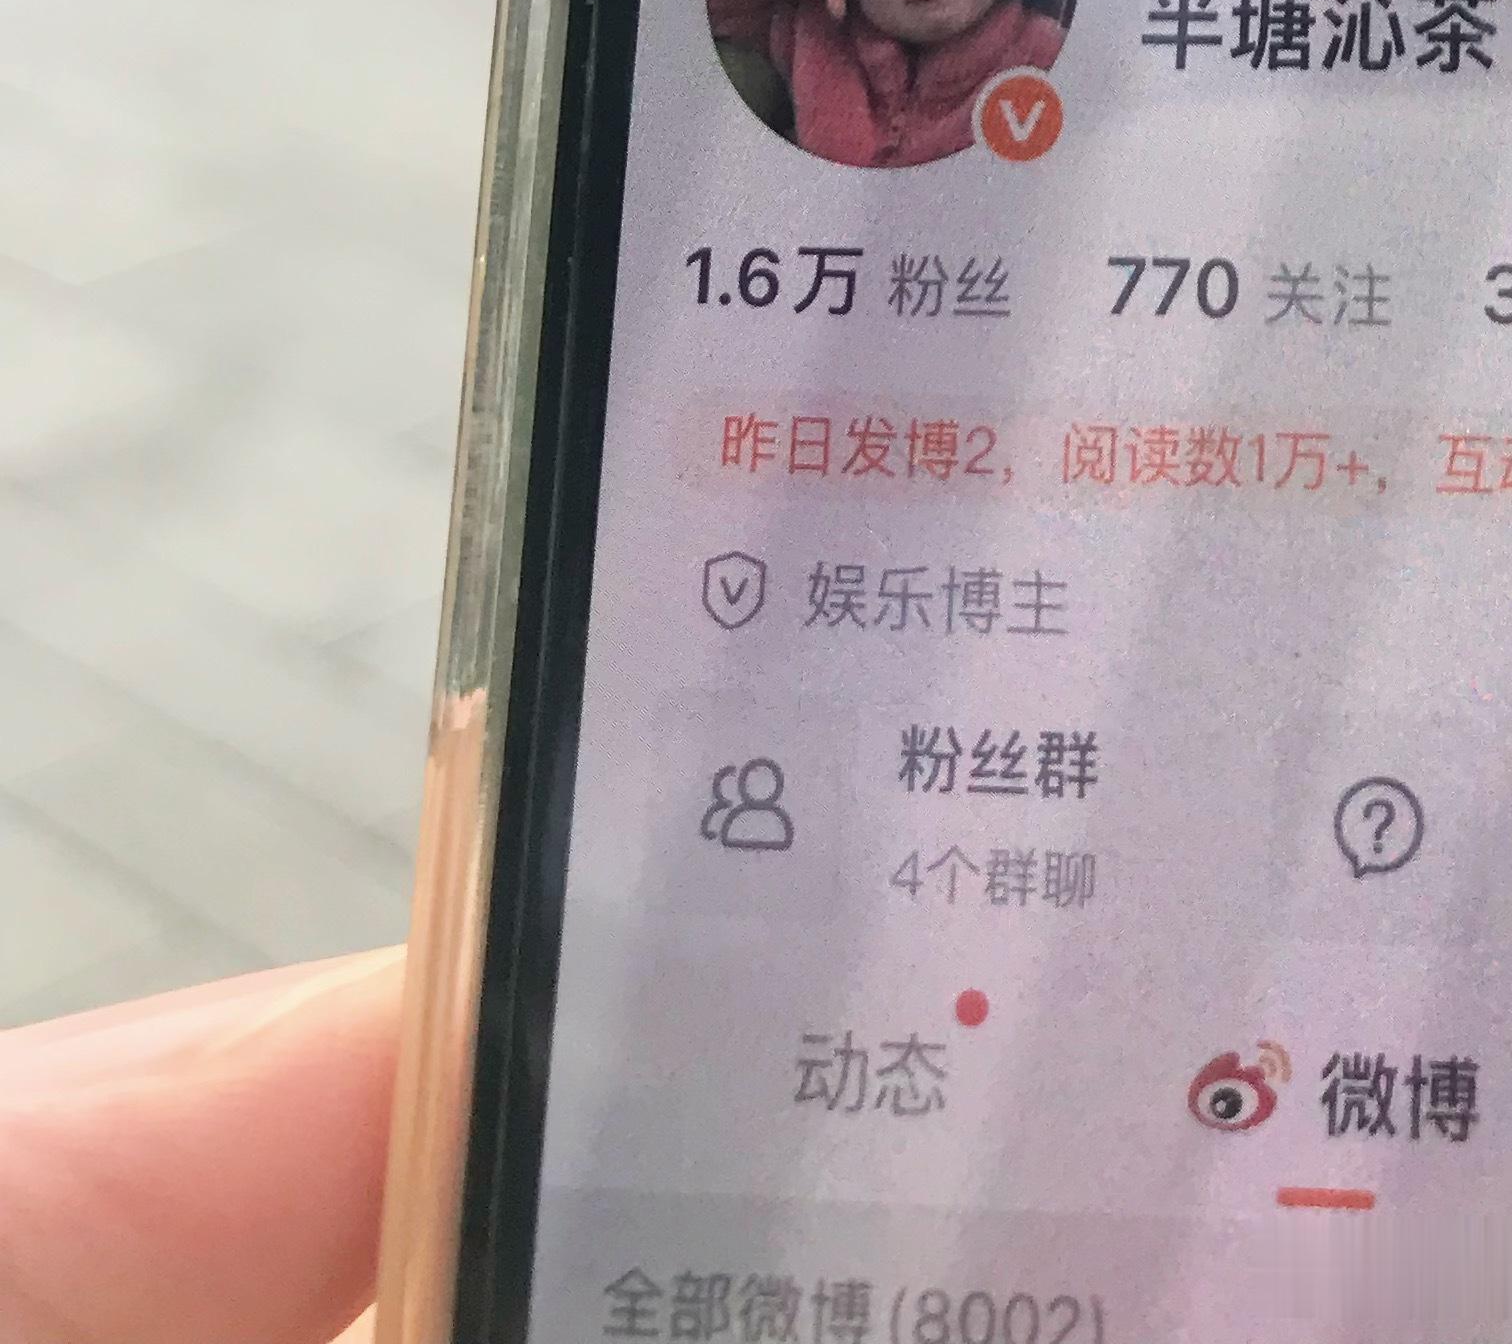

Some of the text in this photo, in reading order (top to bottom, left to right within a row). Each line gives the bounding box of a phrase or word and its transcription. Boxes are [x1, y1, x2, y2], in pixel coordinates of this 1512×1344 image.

[685, 247, 1011, 317] 1.6万 粉丝
[1106, 257, 1392, 327] 770 关注
[803, 561, 1069, 636] 娱乐博主
[899, 724, 1099, 799] 粉丝群
[890, 845, 1097, 910] 4个群聊
[794, 1031, 949, 1116] 动态
[1320, 1051, 1481, 1143] 微博
